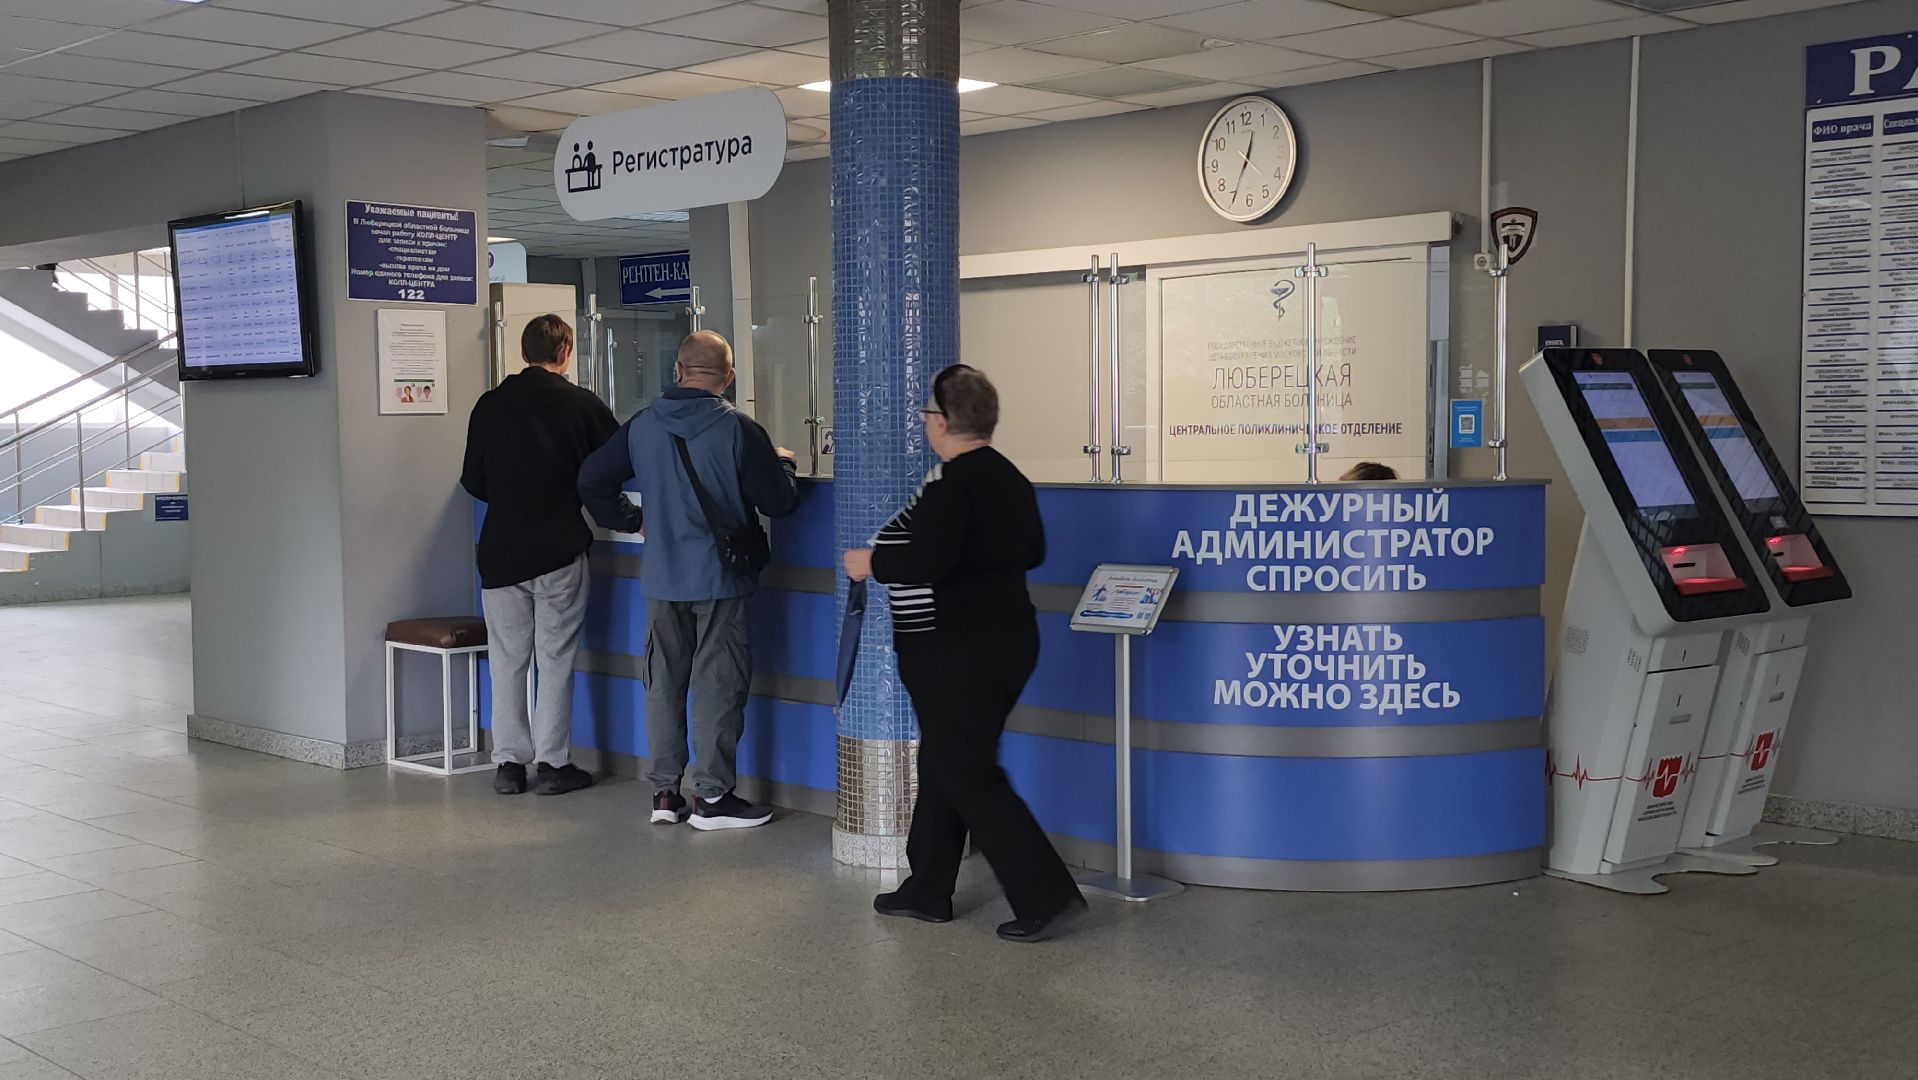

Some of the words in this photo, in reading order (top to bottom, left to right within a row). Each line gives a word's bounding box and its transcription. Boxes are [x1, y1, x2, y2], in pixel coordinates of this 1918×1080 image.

[1849, 46, 1918, 96] Р
[1240, 111, 1251, 126] 12
[1261, 114, 1265, 127] 1
[1226, 121, 1235, 135] 11
[1273, 125, 1279, 139] 2
[1814, 124, 1838, 136] ФИО
[1841, 122, 1872, 135] врача
[1215, 138, 1225, 151] 10
[612, 134, 753, 175] Регистратура
[1211, 159, 1218, 173] 9
[1274, 167, 1281, 180] 4
[1218, 178, 1226, 191] 8
[1262, 184, 1269, 198] 5
[1245, 194, 1253, 207] 6
[365, 204, 415, 217] Уважаемые
[417, 209, 459, 222] пациенты!
[404, 222, 438, 231] областной
[392, 230, 414, 239] работу
[351, 269, 373, 277] Номер
[404, 272, 434, 280] телефона
[623, 261, 690, 284] РЕНТГЕН-КА
[398, 289, 425, 300] 122
[1212, 393, 1281, 409] ОБЛАСТНАЯ
[1284, 392, 1352, 410] БОЛНИЦА
[1169, 423, 1236, 437] ЦЕНТРАЛЬНОЕ
[1341, 422, 1402, 437] ОТДЕЛЕНИЕ
[1229, 488, 1450, 529] ДЕЖУРНЫЙ
[1171, 527, 1495, 565] АДМИНИСТРАТОР
[1246, 564, 1427, 593] СПРОСИТЬ
[1274, 624, 1403, 652] УЗНАТЬ
[1245, 652, 1426, 680] УТОЧНИТЬ
[1213, 680, 1351, 711] МОЖНО
[1359, 682, 1461, 715] ЗДЕСЬ
